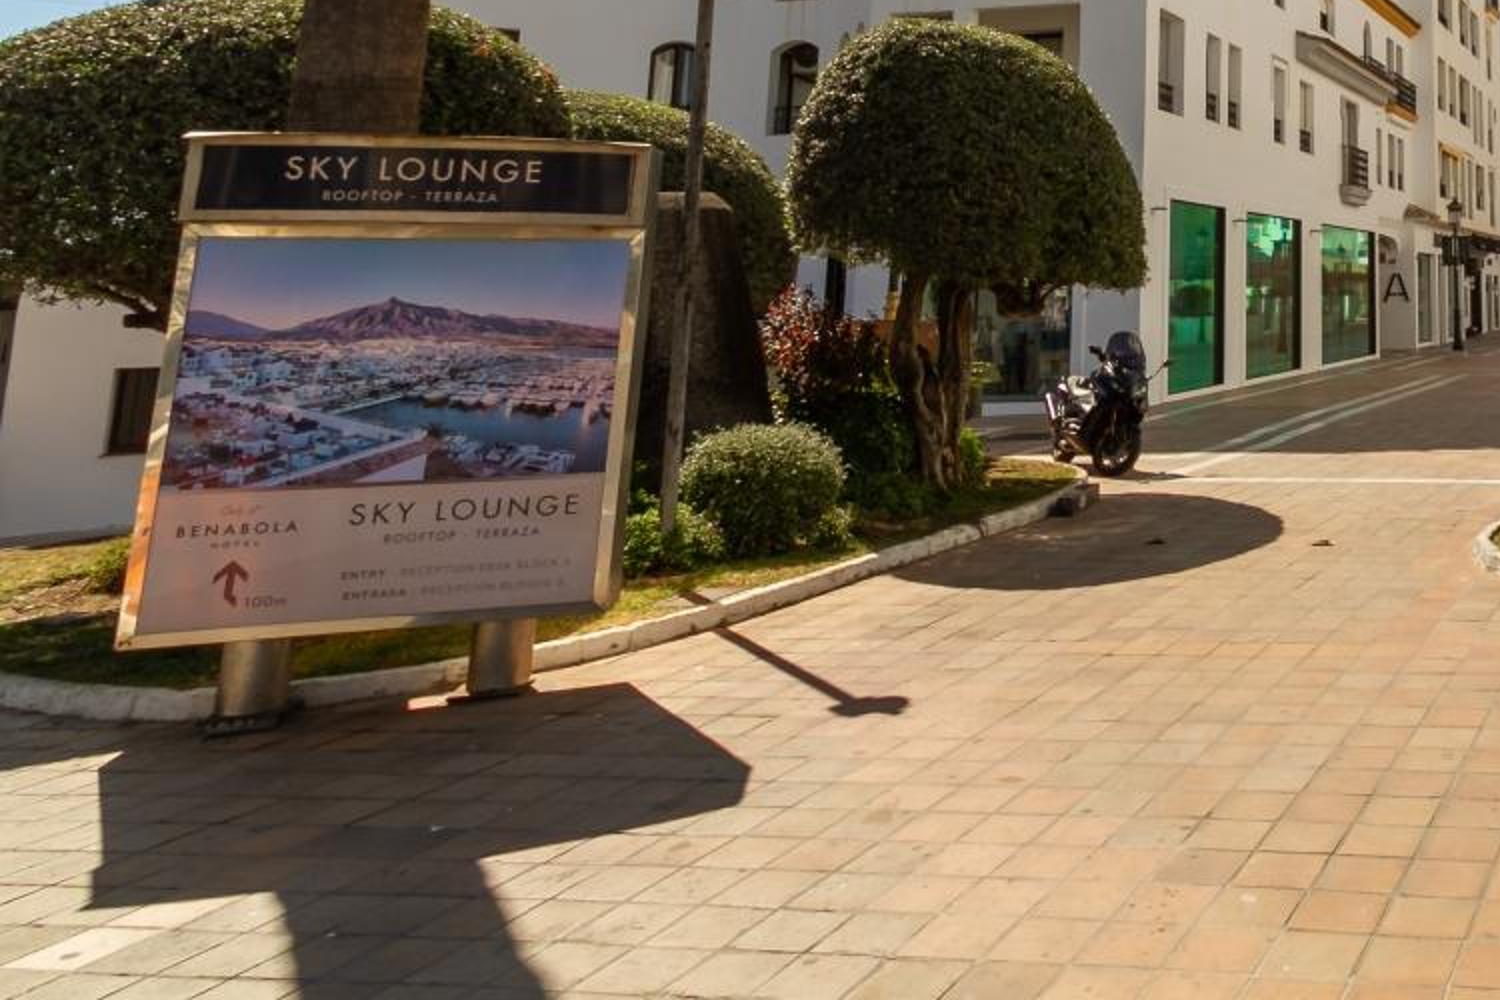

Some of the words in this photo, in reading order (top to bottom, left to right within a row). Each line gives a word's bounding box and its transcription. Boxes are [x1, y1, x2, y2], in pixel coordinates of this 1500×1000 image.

[285, 156, 358, 181] SKY
[378, 157, 543, 184] LOUNGE
[322, 188, 403, 202] ROOFTOP
[425, 190, 498, 203] TERRAZA
[1384, 273, 1409, 303] A
[349, 502, 416, 526] SKY
[436, 493, 580, 522] LOUNGE
[176, 520, 299, 538] BENABOLA
[383, 530, 457, 544] ROOFTOP
[475, 527, 541, 540] TERRAZA
[340, 568, 386, 581] ENTRY
